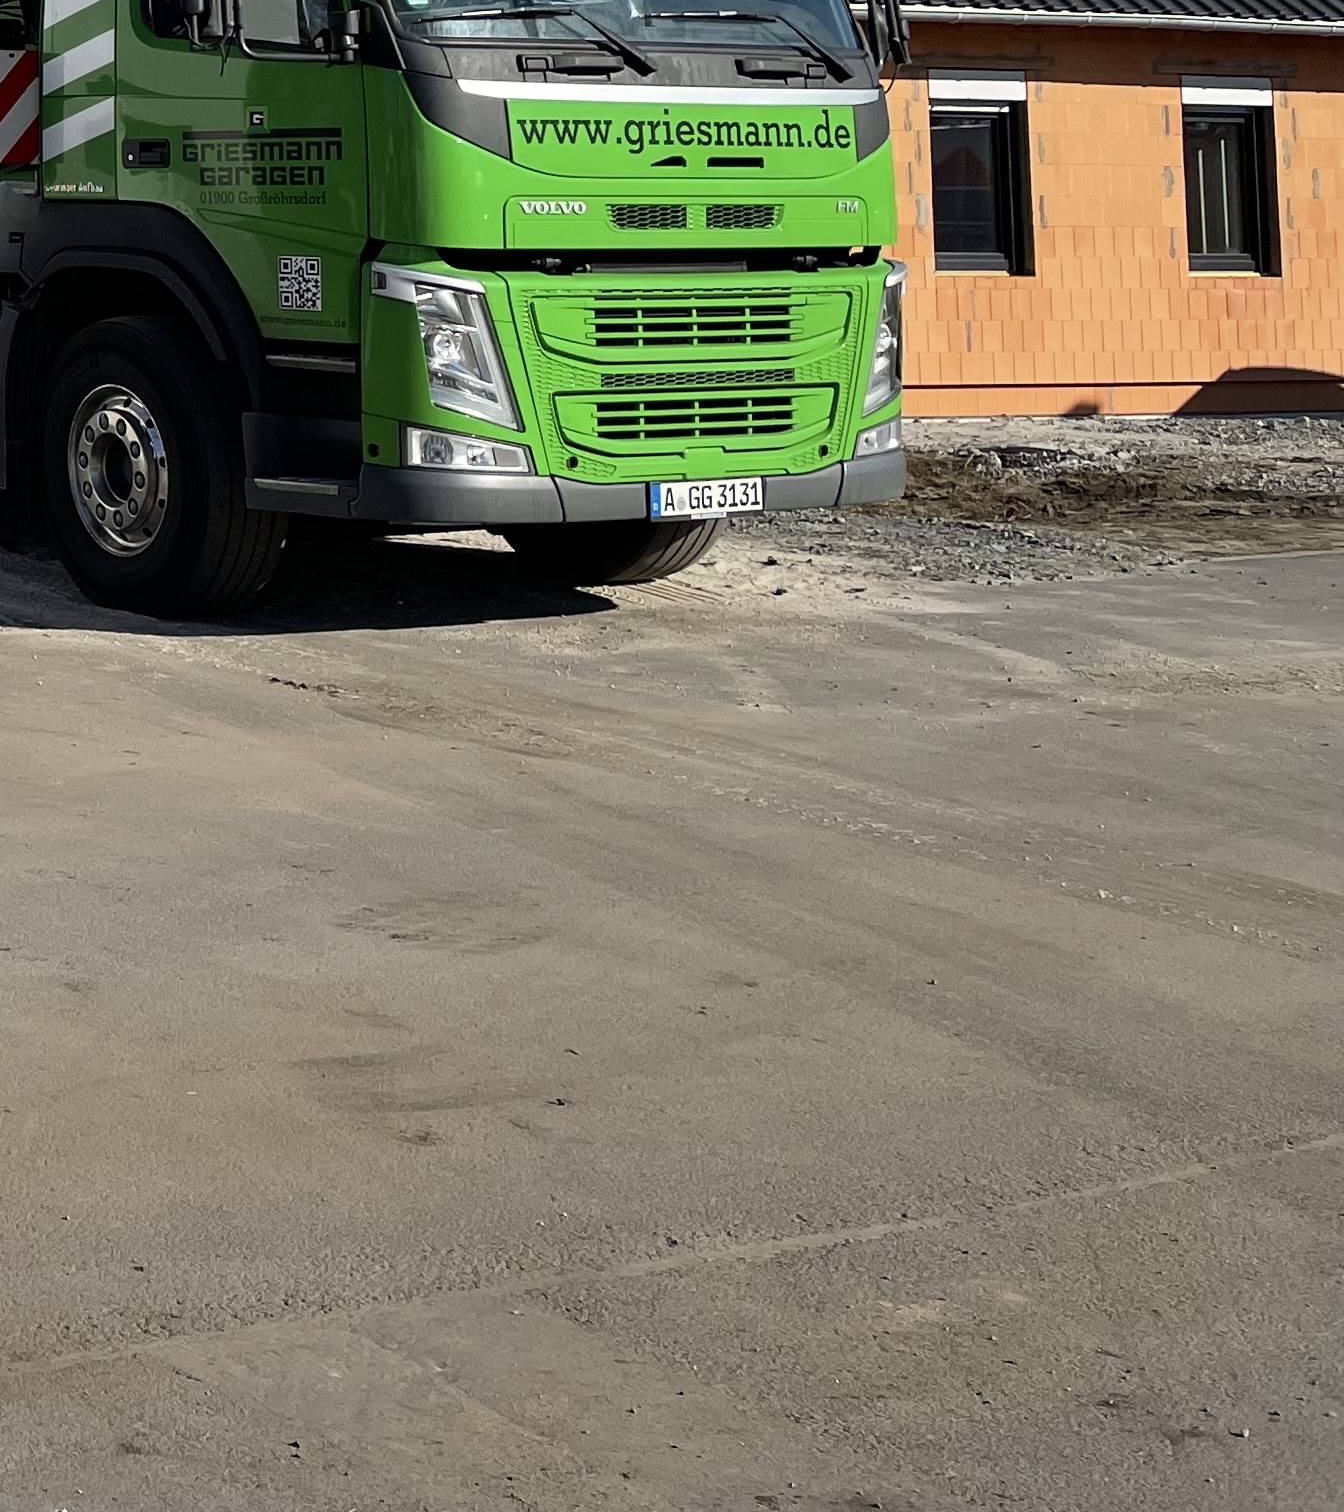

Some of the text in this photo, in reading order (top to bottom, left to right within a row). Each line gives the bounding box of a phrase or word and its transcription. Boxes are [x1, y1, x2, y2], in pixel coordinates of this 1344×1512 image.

[515, 108, 851, 154] www.griesmann.de
[200, 191, 327, 205] 01900 Großröhrsdorf
[519, 201, 587, 215] VOLVO
[836, 200, 858, 214] FM
[664, 482, 760, 511] A GG 3131
